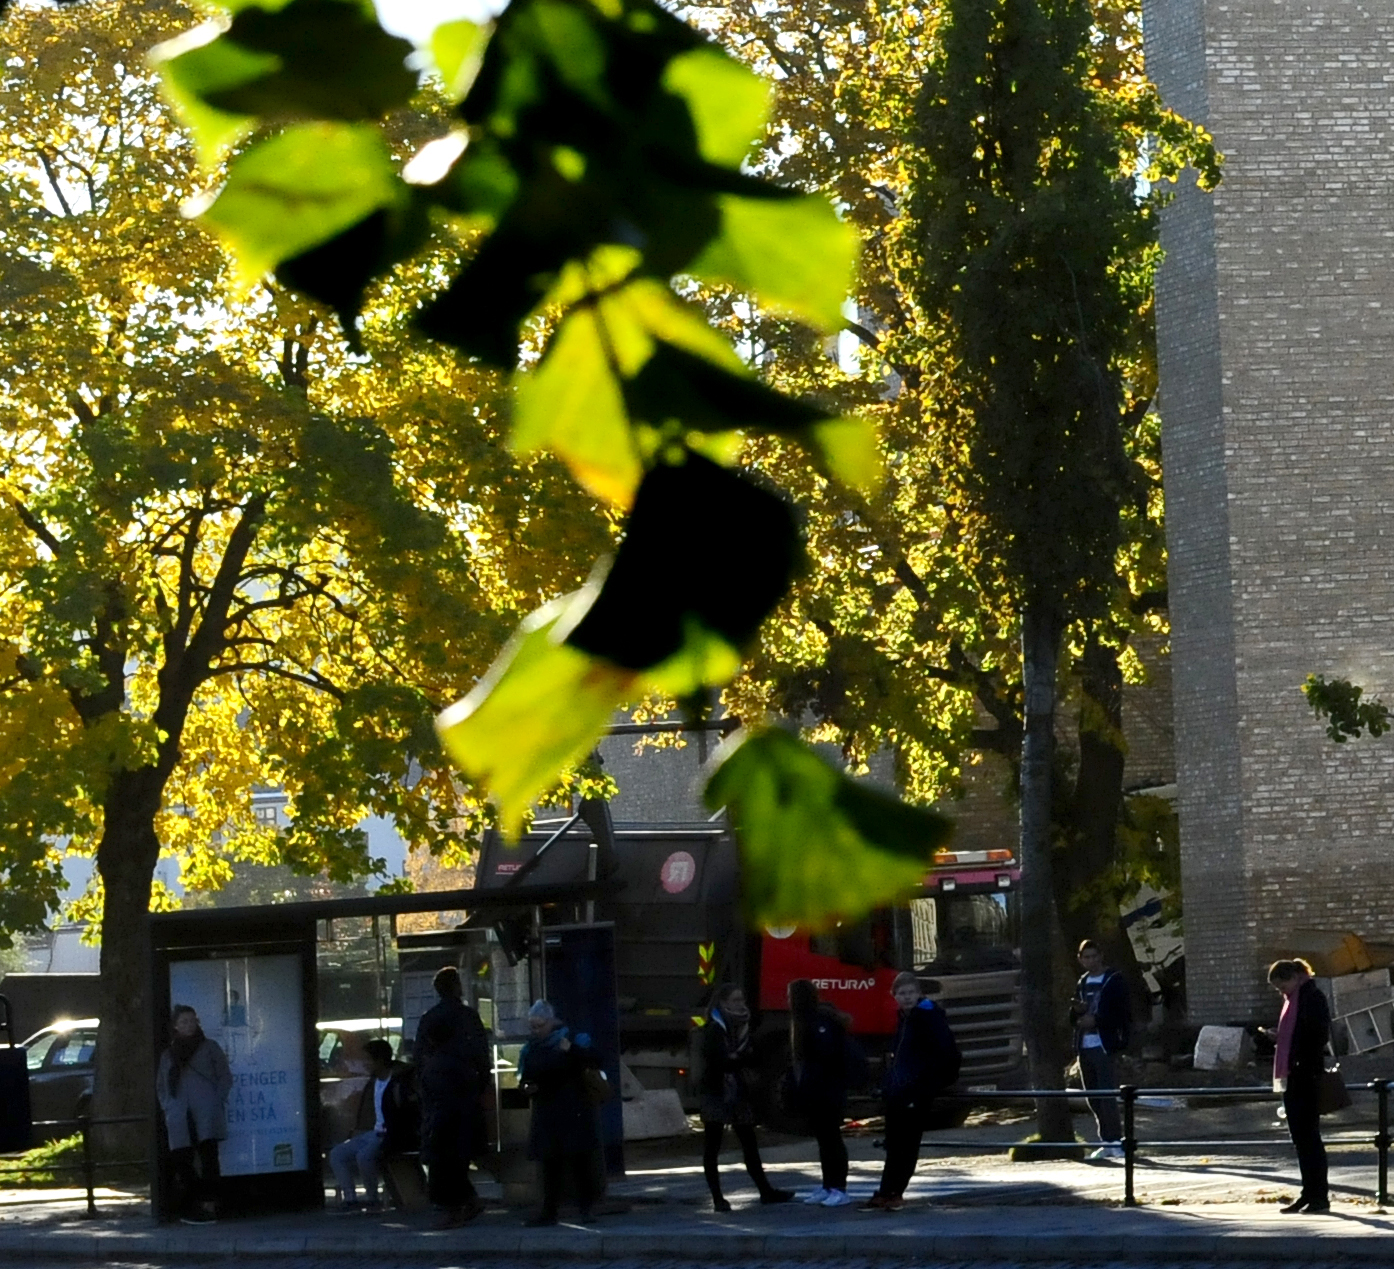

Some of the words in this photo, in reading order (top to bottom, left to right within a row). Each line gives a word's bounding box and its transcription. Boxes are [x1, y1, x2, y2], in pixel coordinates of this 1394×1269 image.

[811, 978, 869, 990] RETURA
[249, 1090, 266, 1105] LA
[251, 1103, 277, 1122] STÅ
